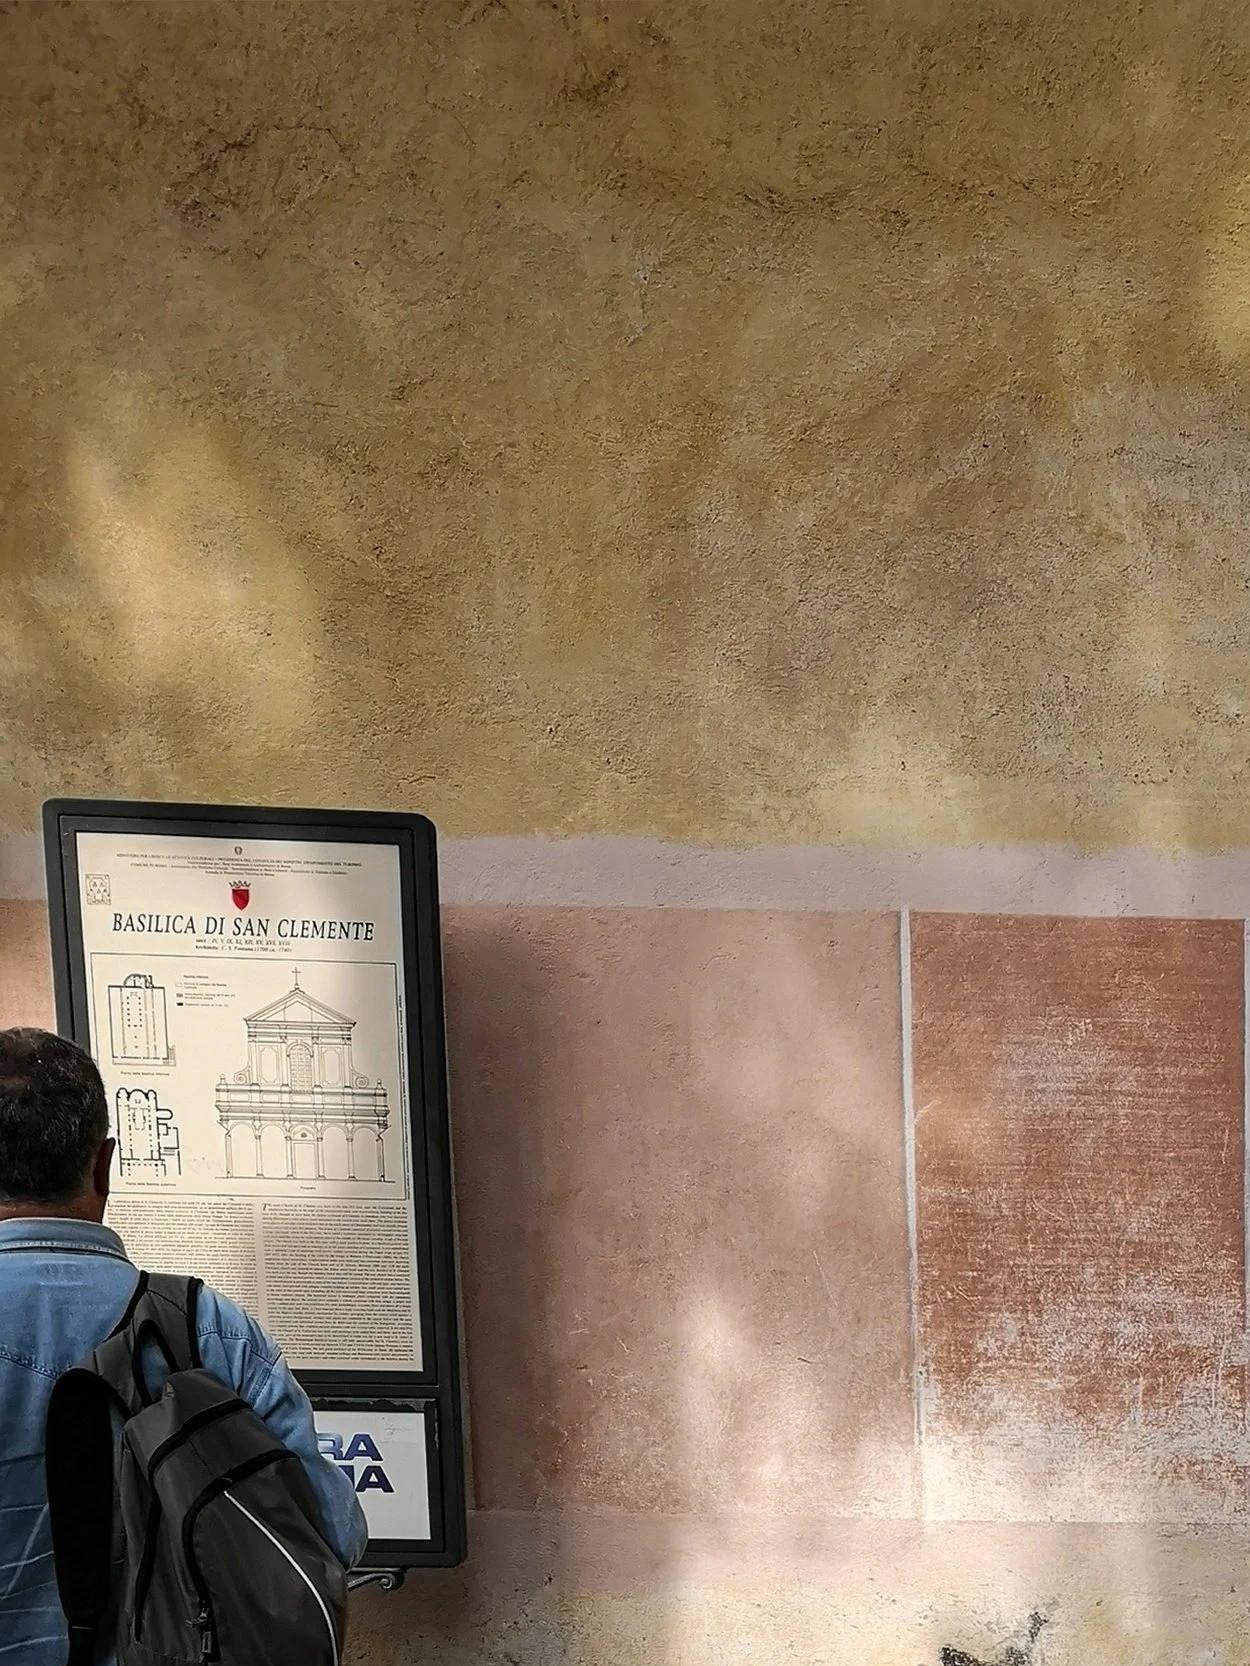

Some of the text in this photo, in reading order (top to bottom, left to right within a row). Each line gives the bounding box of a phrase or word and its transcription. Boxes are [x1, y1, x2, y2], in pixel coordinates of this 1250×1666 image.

[112, 913, 374, 941] BASILICA DI SAN CLEMENTE
